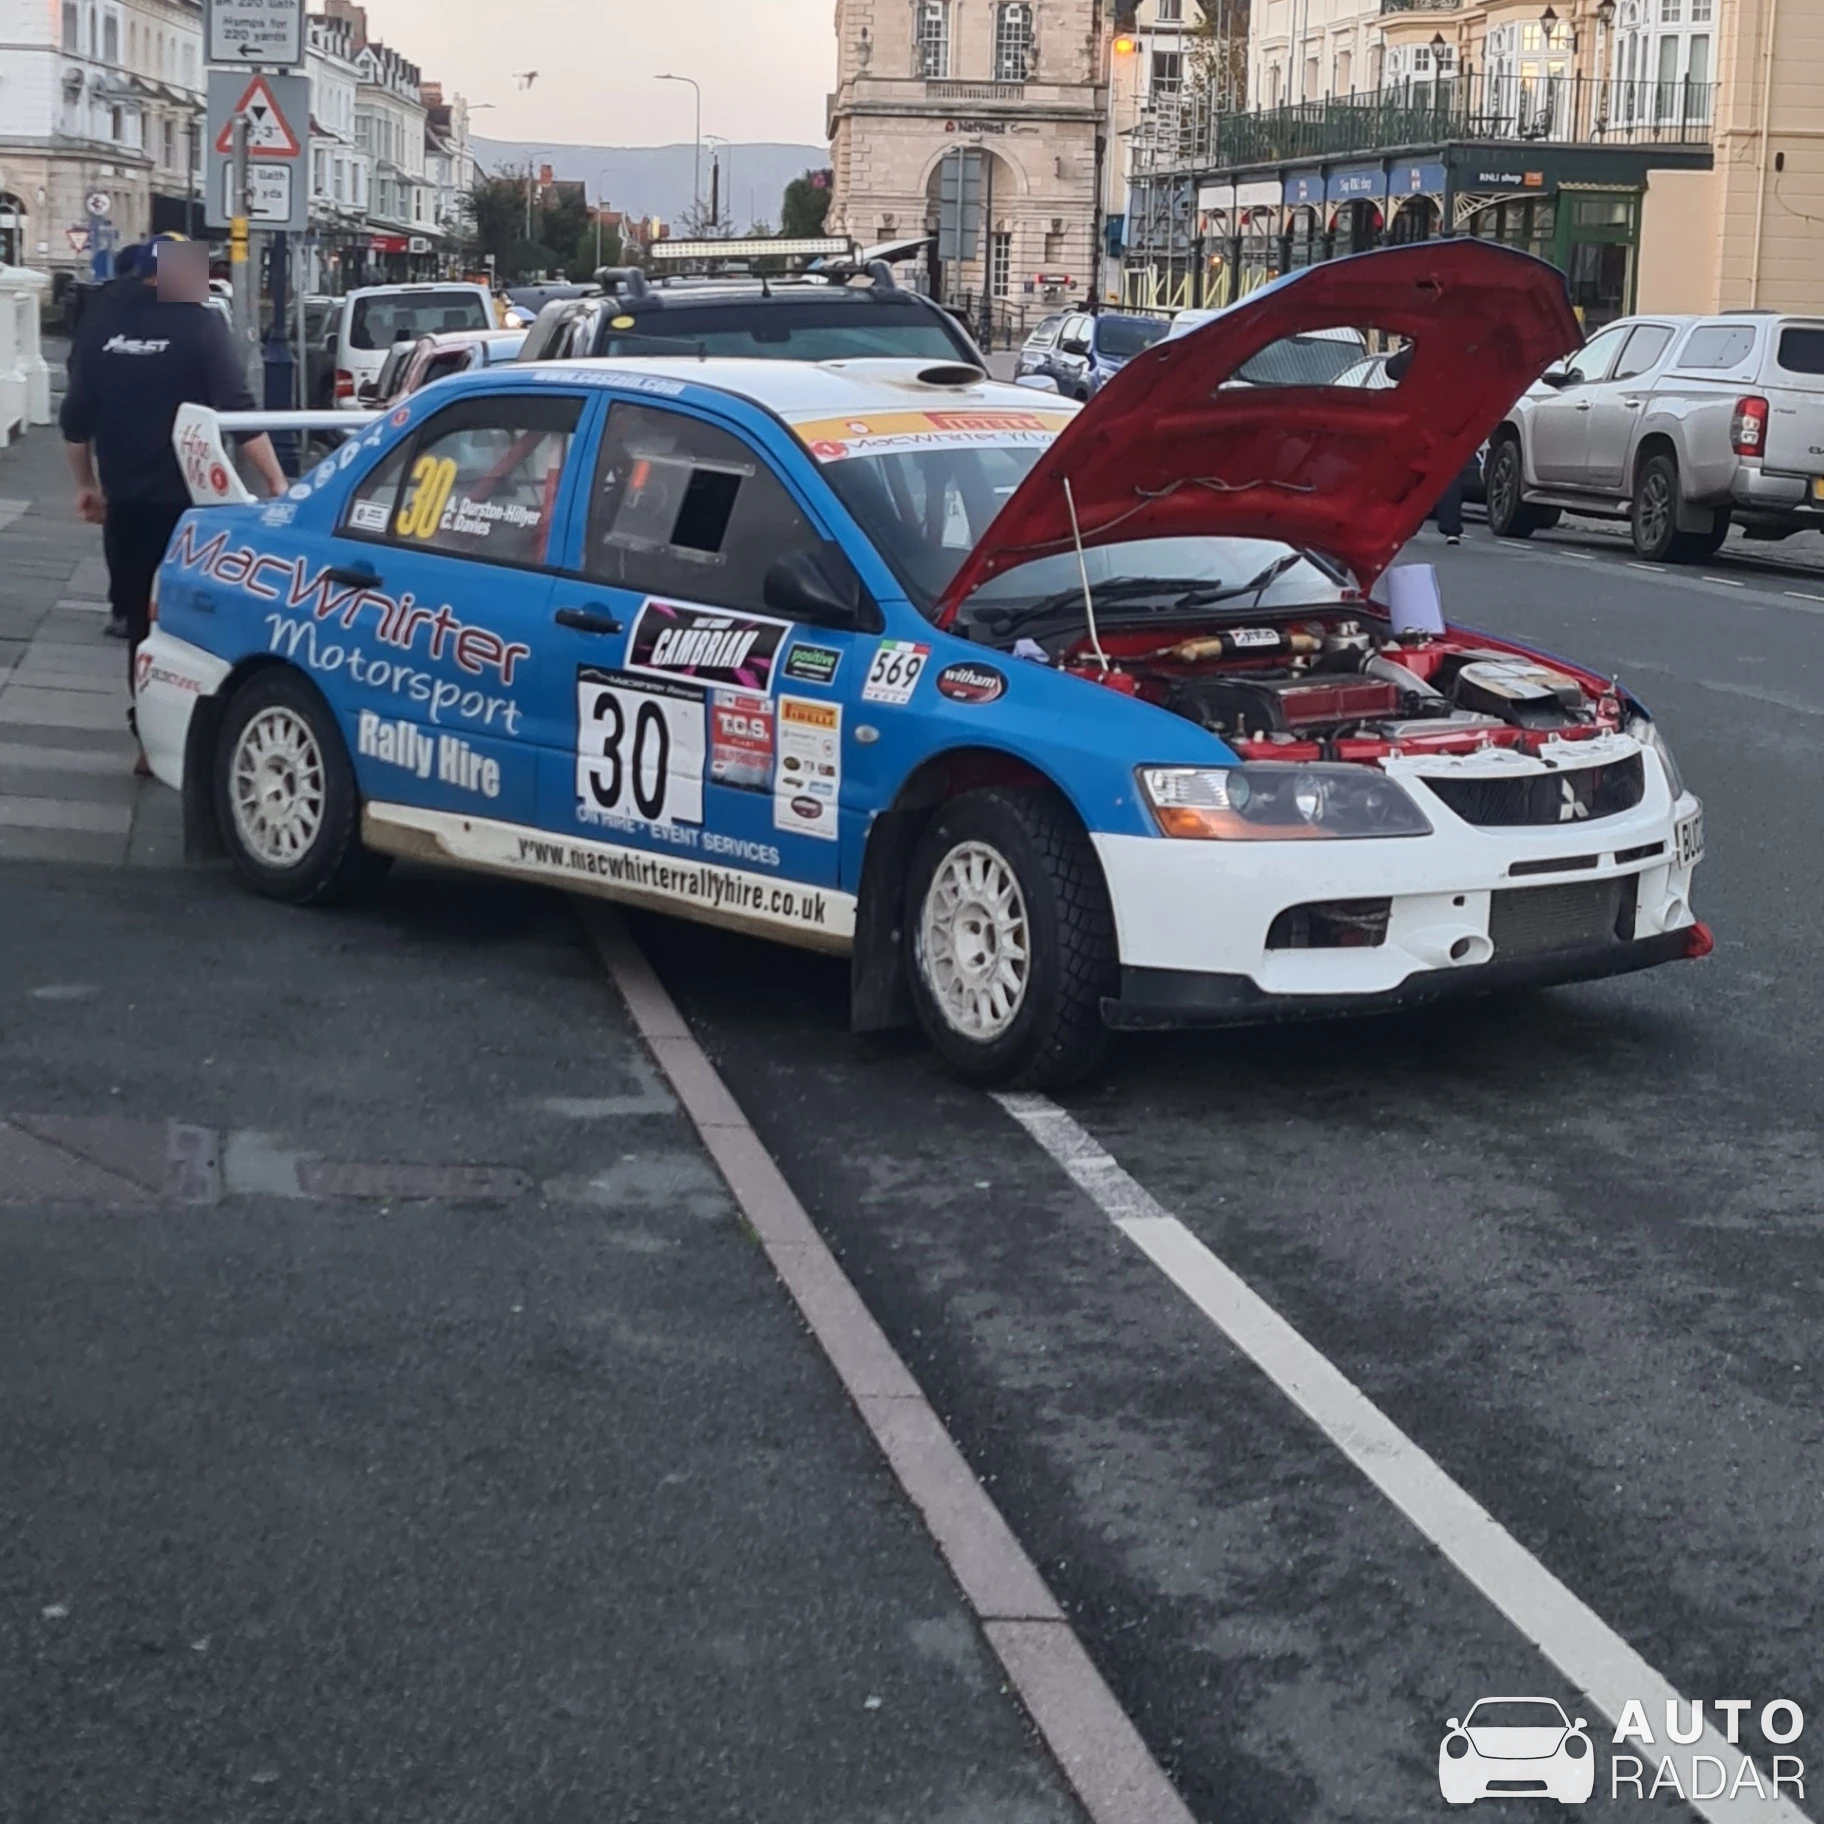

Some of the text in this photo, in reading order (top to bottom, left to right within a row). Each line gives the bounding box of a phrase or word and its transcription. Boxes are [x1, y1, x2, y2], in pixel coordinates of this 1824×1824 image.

[223, 16, 287, 29] Humps for
[224, 29, 287, 42] 220 yards
[958, 120, 1005, 134] NatWest
[1479, 172, 1500, 182] RNLI
[1501, 172, 1522, 185] shop
[922, 411, 1049, 431] PIRELLI
[396, 454, 458, 540] 30
[445, 496, 457, 513] A.
[440, 514, 491, 536] C. Davies
[164, 520, 531, 686] MacWhirter
[650, 628, 760, 668] CAMBRIAN
[791, 649, 836, 667] positive
[265, 612, 522, 736] Motorsport
[871, 651, 921, 688] 569
[944, 667, 997, 688] witham
[358, 709, 500, 798] Rally Hire
[589, 692, 669, 820] 30
[651, 824, 698, 848] EVENT
[702, 831, 781, 866] SERVICES
[518, 837, 826, 924] www.macwhirterrallyhire.co.uk
